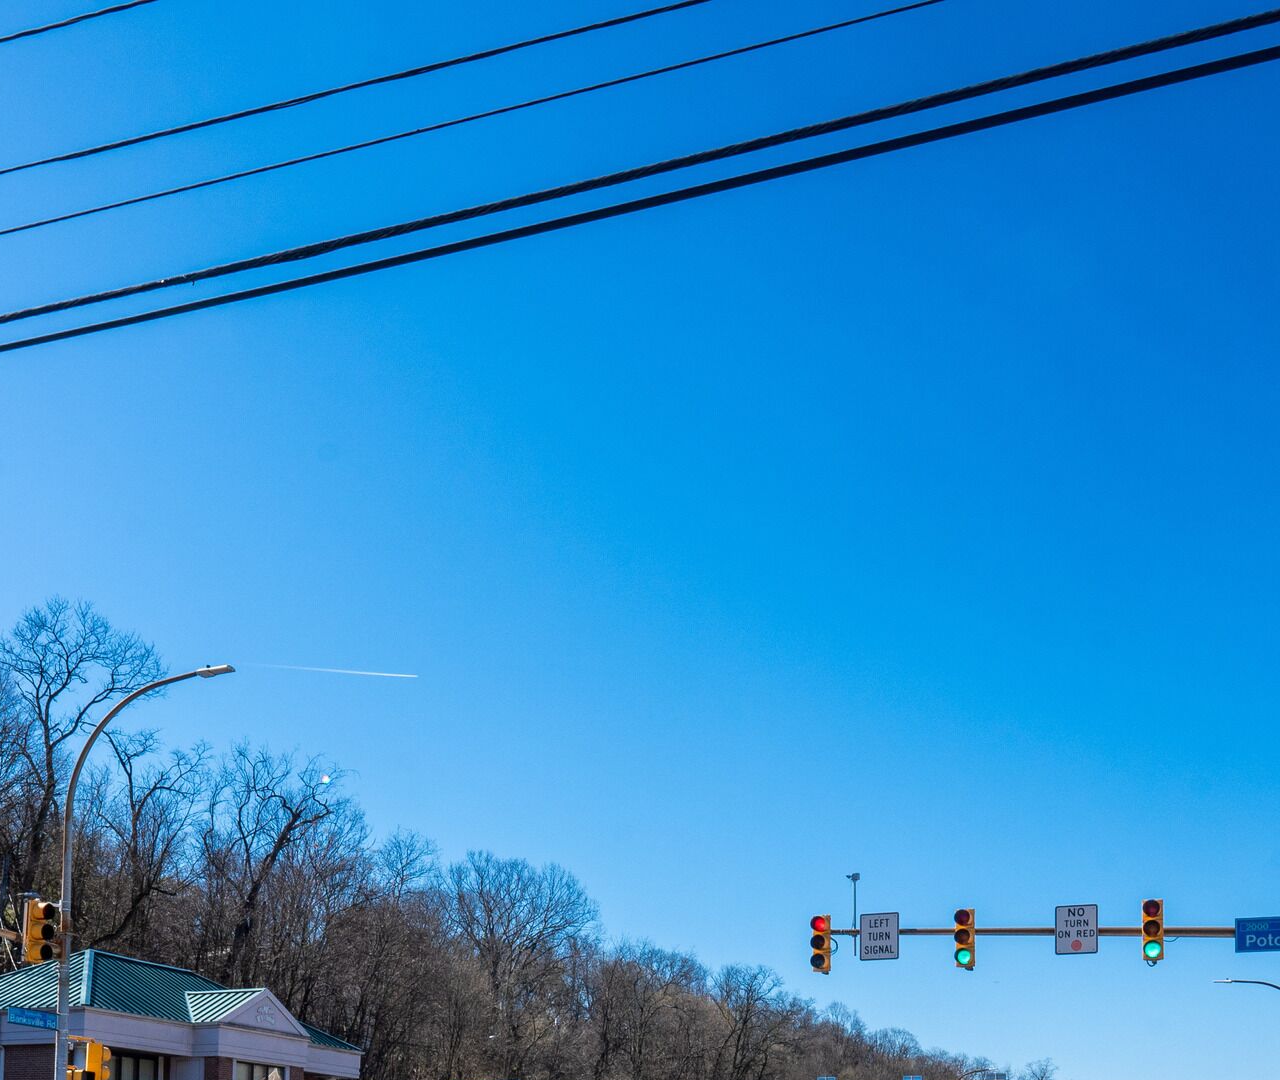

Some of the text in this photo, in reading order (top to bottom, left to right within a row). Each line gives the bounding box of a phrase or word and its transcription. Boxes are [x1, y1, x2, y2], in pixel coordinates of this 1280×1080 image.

[1067, 907, 1085, 917] NO
[869, 918, 890, 928] LEFT
[1064, 919, 1089, 928] TURN
[868, 931, 891, 941] TURN
[1057, 929, 1095, 939] ON RED
[864, 944, 895, 955] SIGNAL
[10, 1013, 45, 1027] Banksville
[46, 1020, 56, 1029] Rd
